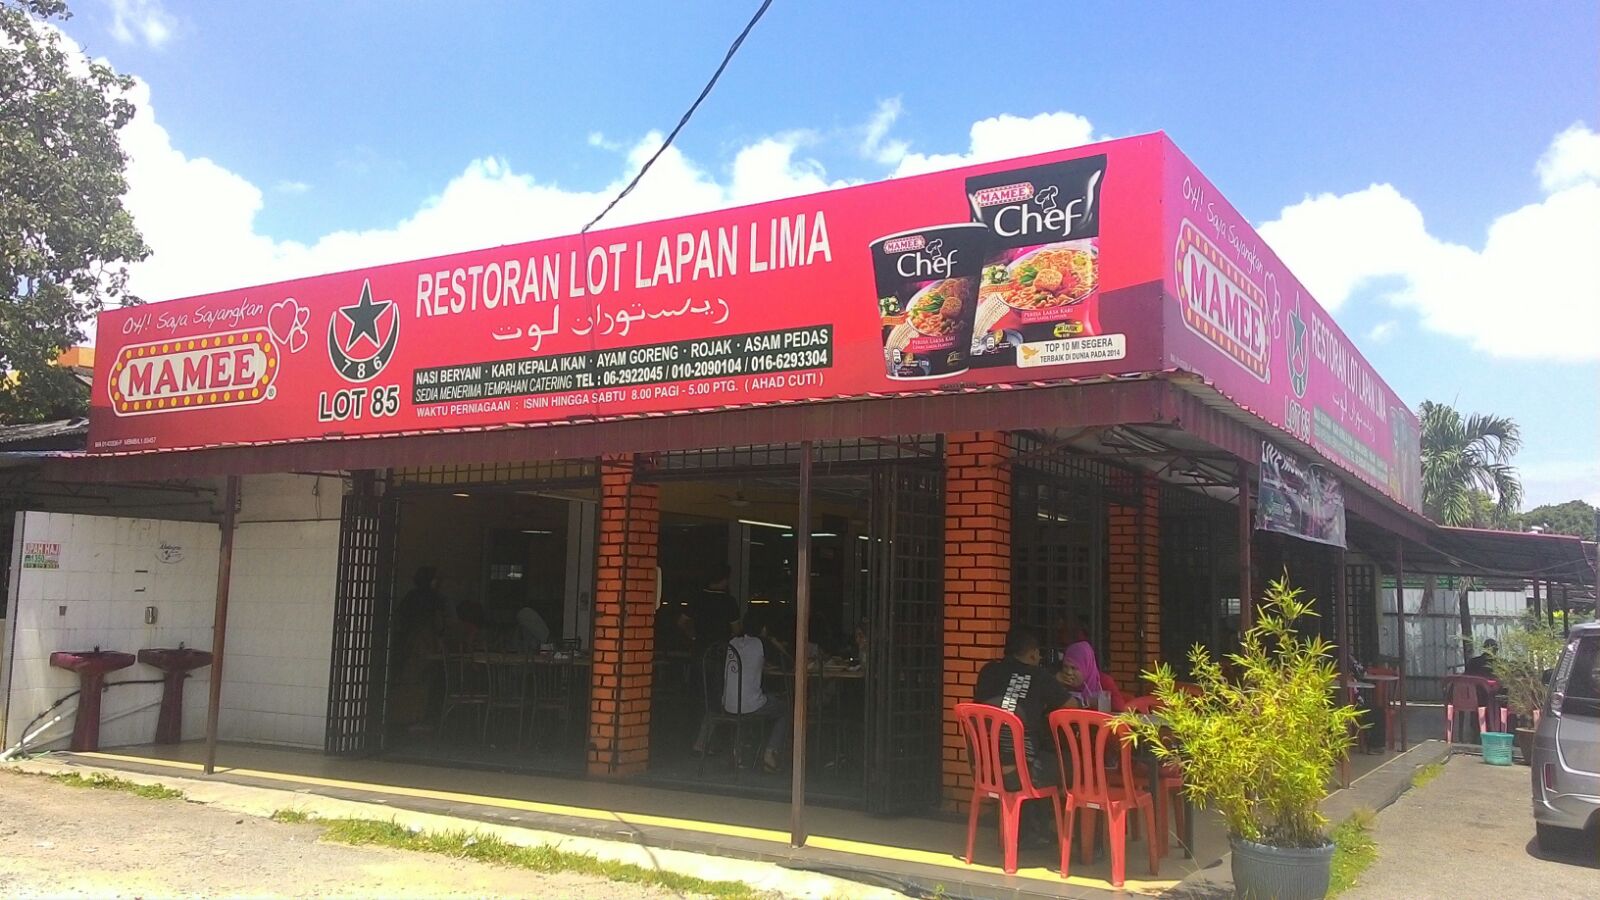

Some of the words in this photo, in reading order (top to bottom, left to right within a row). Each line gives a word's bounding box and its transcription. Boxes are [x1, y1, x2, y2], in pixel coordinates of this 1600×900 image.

[980, 187, 1027, 203] MAMEE
[994, 198, 1083, 237] Chef
[887, 239, 920, 251] MAMEE
[1206, 202, 1227, 240] Saya
[1228, 225, 1264, 275] Sayangkan
[415, 252, 561, 319] RESTORAN
[569, 242, 627, 299] LOT
[634, 224, 738, 289] LAPAN
[748, 210, 833, 275] LIMA
[896, 249, 959, 278] Chef
[122, 312, 152, 335] OH!
[156, 312, 188, 335] Saya
[192, 297, 264, 328] Sayangkan
[1189, 253, 1264, 356] MAMEE
[491, 303, 560, 352] لوت
[1045, 342, 1060, 353] TOP
[1061, 342, 1070, 352] 10
[1071, 341, 1081, 350] MI
[1081, 337, 1113, 350] SEGERA
[341, 356, 383, 379] 786
[416, 372, 439, 385] NASI
[440, 366, 482, 383] BERYANI
[491, 363, 517, 379] KARI
[518, 358, 558, 376] KEPALA
[560, 356, 587, 372] IKAN
[596, 351, 627, 368] AYAM
[629, 345, 679, 365] GORENG
[690, 339, 733, 358] ROJAK
[743, 334, 781, 353] ASAM
[784, 328, 829, 349] PEDAS
[1040, 354, 1065, 363] TERBAIK
[1065, 353, 1072, 361] DI
[1072, 352, 1090, 360] DUNIA
[1090, 350, 1107, 359] PADA
[1107, 348, 1120, 357] 2014
[1311, 311, 1347, 385] RESTORAN
[127, 348, 256, 397] MAMEE
[416, 387, 439, 402] SEDIA
[439, 383, 482, 400] MENERIMA
[483, 378, 529, 397] TEMPAHAN
[529, 375, 573, 393] CATERING
[576, 373, 595, 388] TEL
[603, 366, 663, 387] 06-2922045
[671, 357, 742, 380] 010-2090104
[751, 349, 828, 371] 016-6293304
[318, 390, 367, 423] LOT
[371, 384, 400, 417] 85
[416, 405, 448, 417] WAKTU
[450, 400, 511, 415] PERNIAGAAN
[523, 397, 549, 409] ISNIN
[551, 393, 590, 408] HINGGA
[591, 390, 626, 404] SABTU
[631, 388, 652, 400] 8.00
[654, 385, 680, 398] PAGI
[688, 383, 710, 395] 5.00
[713, 380, 739, 393] PTG.
[1284, 395, 1301, 435] LOT
